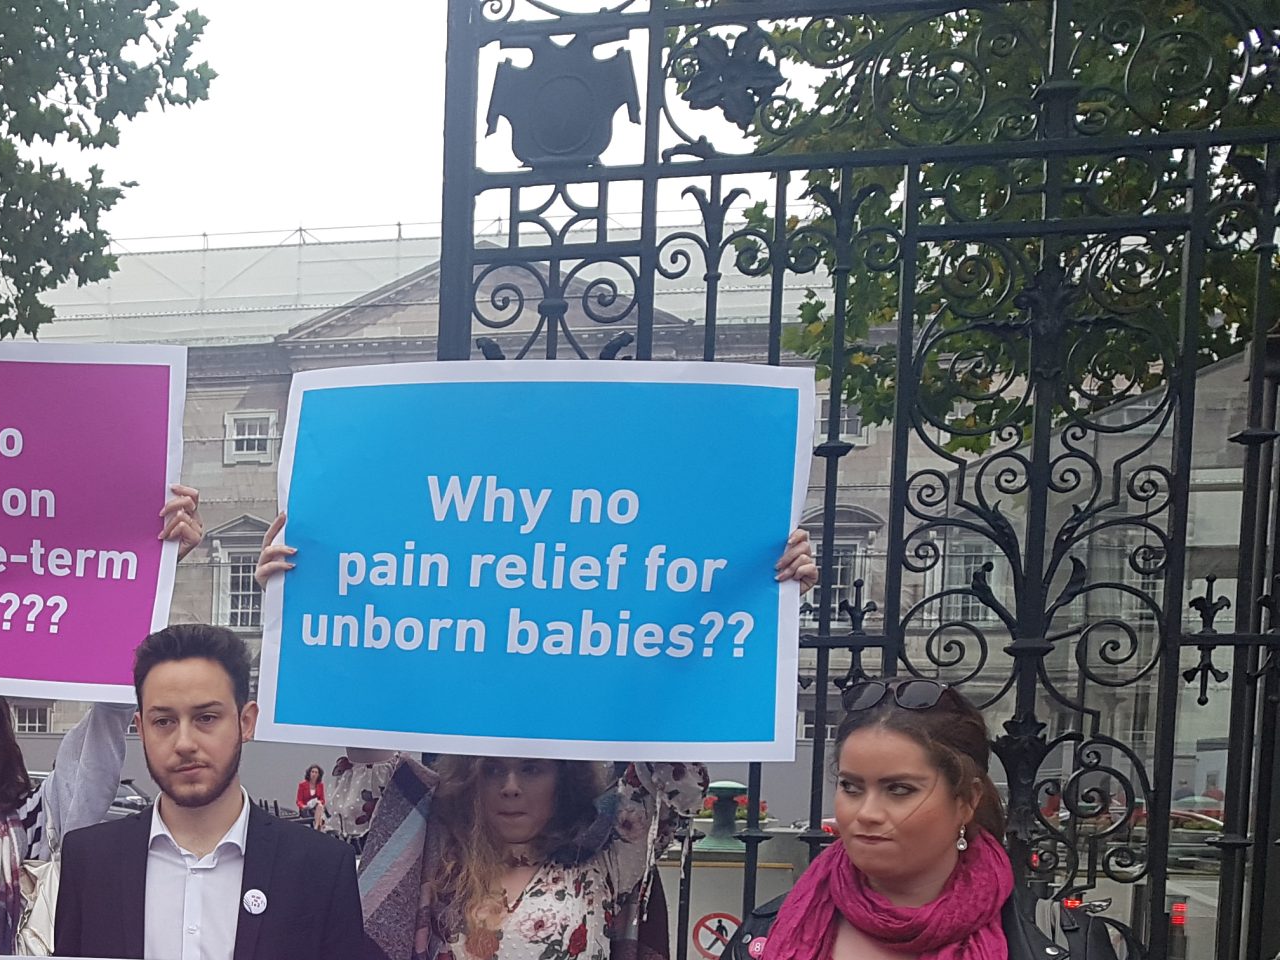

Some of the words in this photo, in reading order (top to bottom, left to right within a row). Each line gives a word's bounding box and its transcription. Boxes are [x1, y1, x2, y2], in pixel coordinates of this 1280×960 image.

[427, 475, 552, 534] Why
[569, 488, 640, 525] no
[338, 540, 449, 596] pain
[469, 542, 628, 591] relief
[644, 544, 728, 593] for
[301, 603, 486, 653] unborn
[506, 603, 755, 659] babies??
